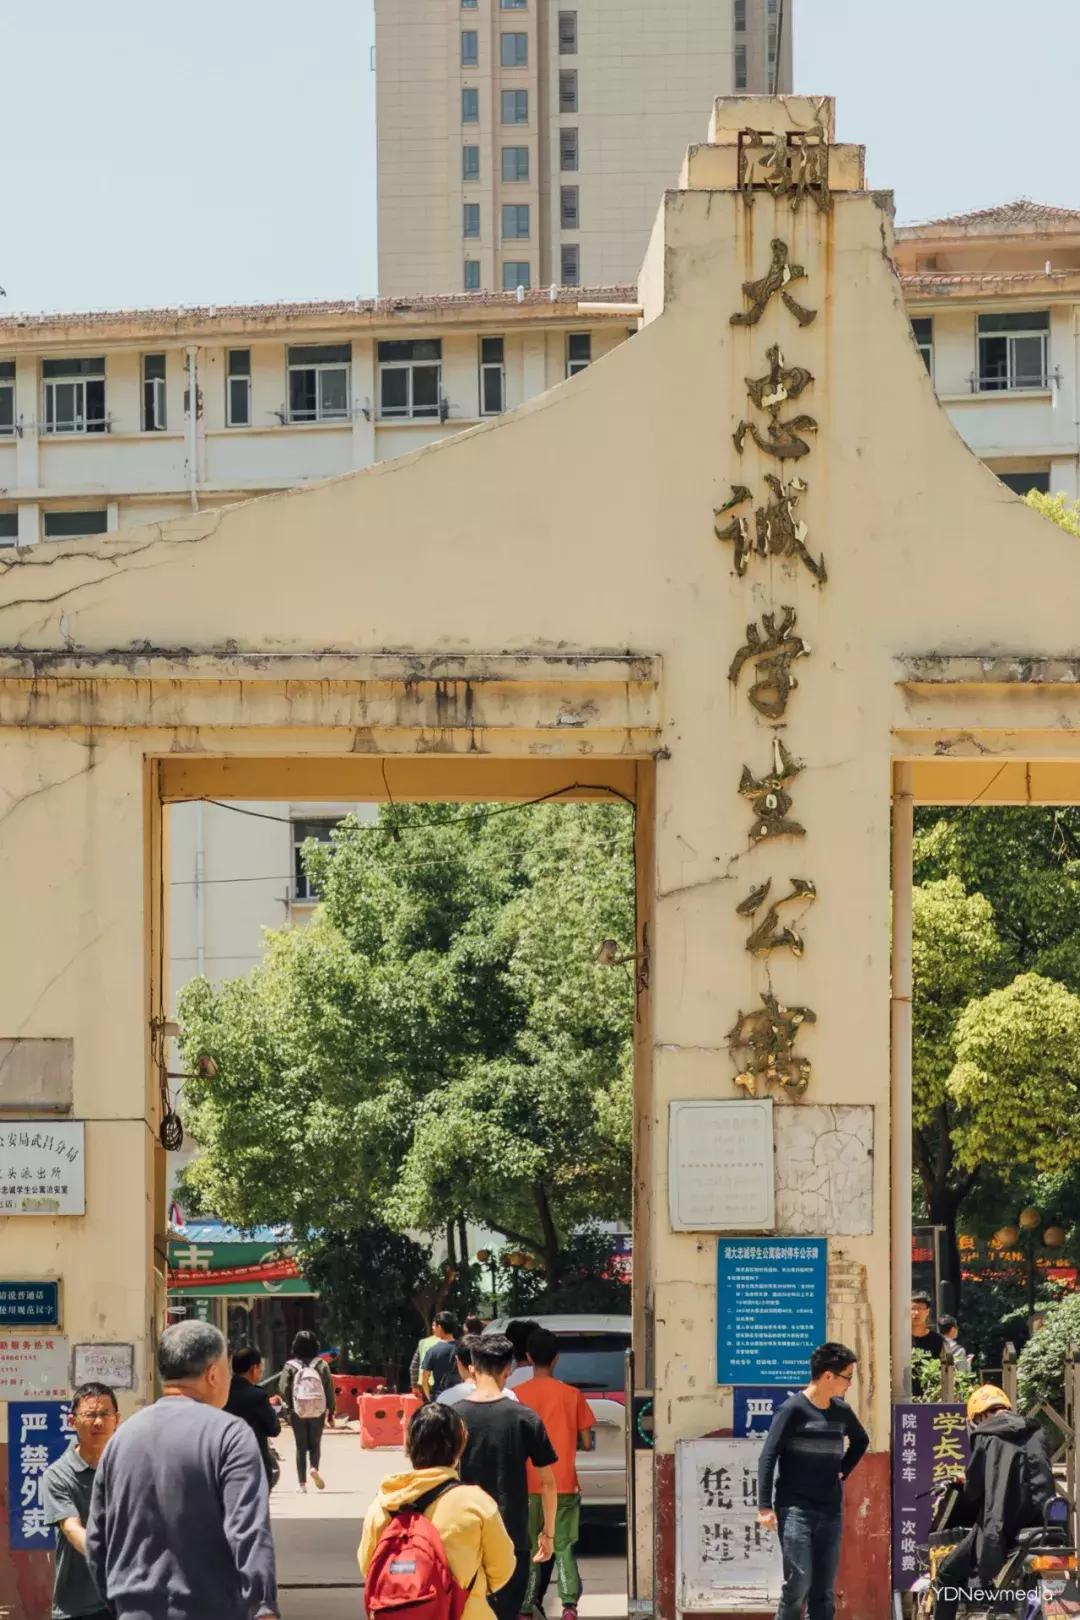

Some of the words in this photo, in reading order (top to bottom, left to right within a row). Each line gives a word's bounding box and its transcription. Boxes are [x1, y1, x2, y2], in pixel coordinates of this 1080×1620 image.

[0, 1185, 68, 1194] 忠诚学生公寓治安室
[20, 1413, 50, 1538] 严禁外卖
[901, 1414, 918, 1483] 院内学车
[901, 1507, 918, 1572] 一次收费
